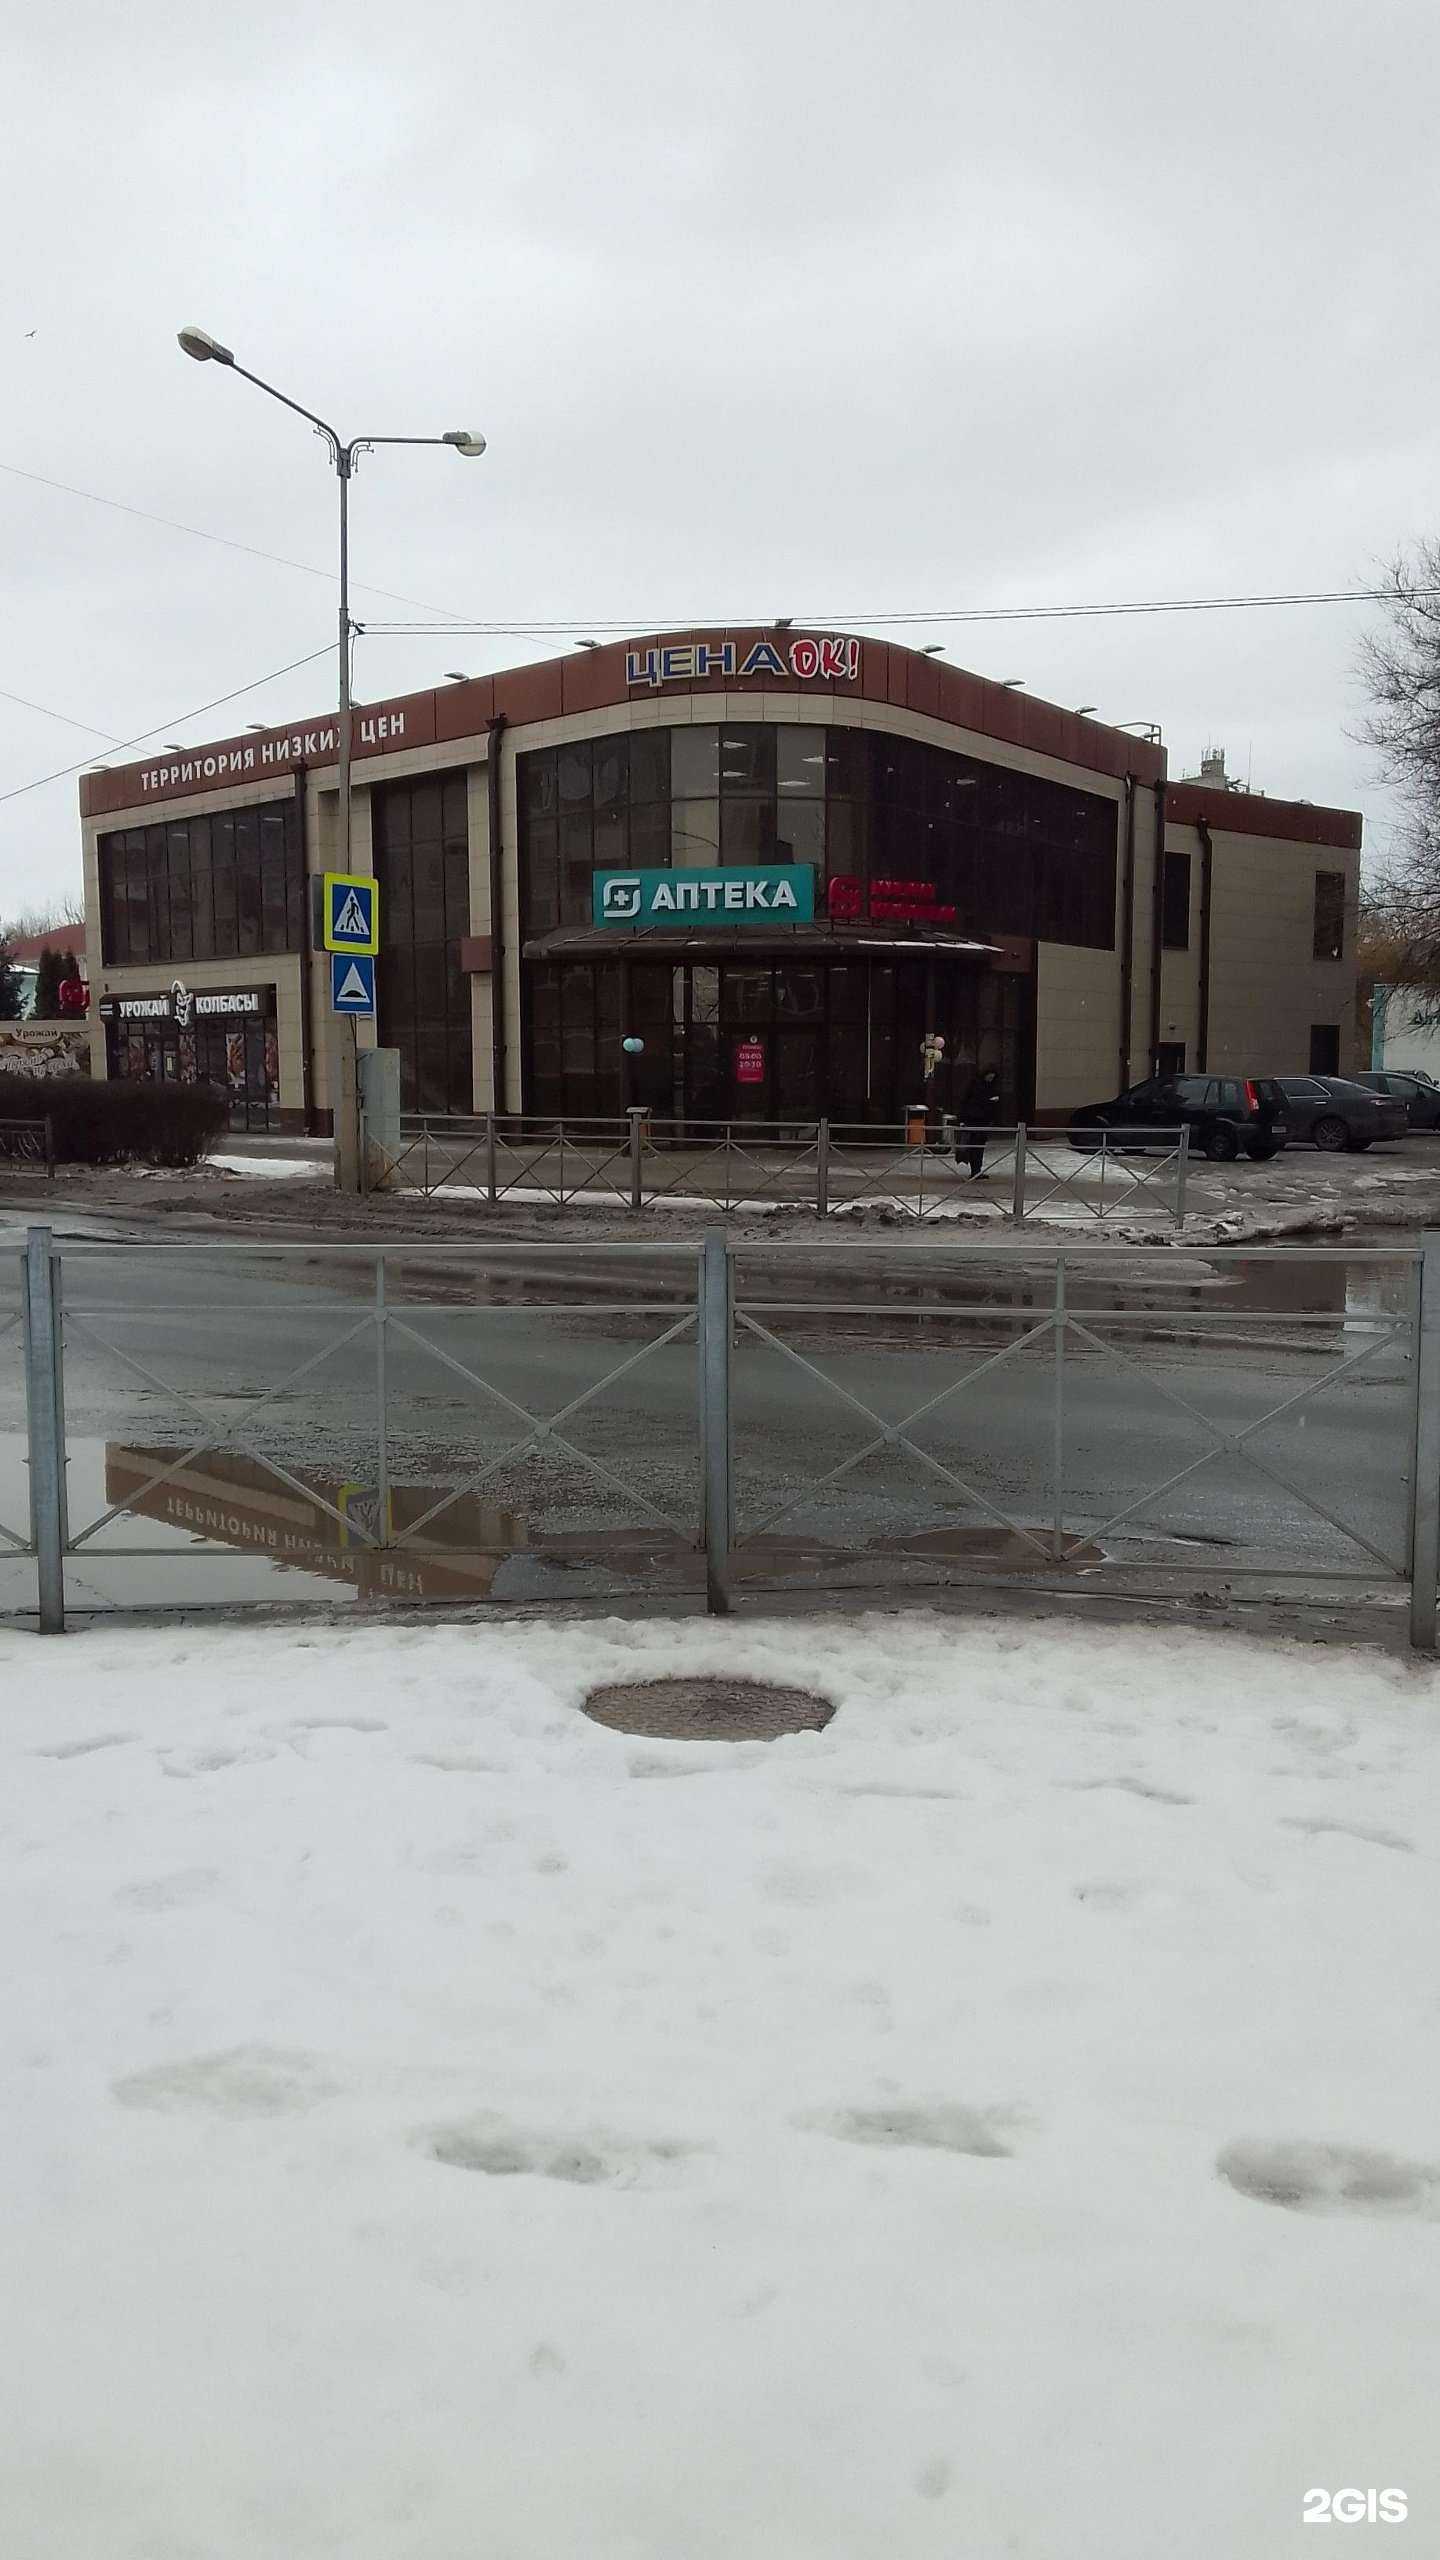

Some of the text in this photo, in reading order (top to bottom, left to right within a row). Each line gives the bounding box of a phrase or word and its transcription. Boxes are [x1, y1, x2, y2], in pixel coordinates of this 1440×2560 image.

[626, 642, 789, 687] ЦЕНА
[141, 751, 255, 791] ТЕРРИТОРИЯ
[360, 712, 405, 744] ЦЕН
[651, 880, 797, 910] АПТЕКА
[119, 993, 259, 1018] УРОЖАЙ КОЛБАСЫ
